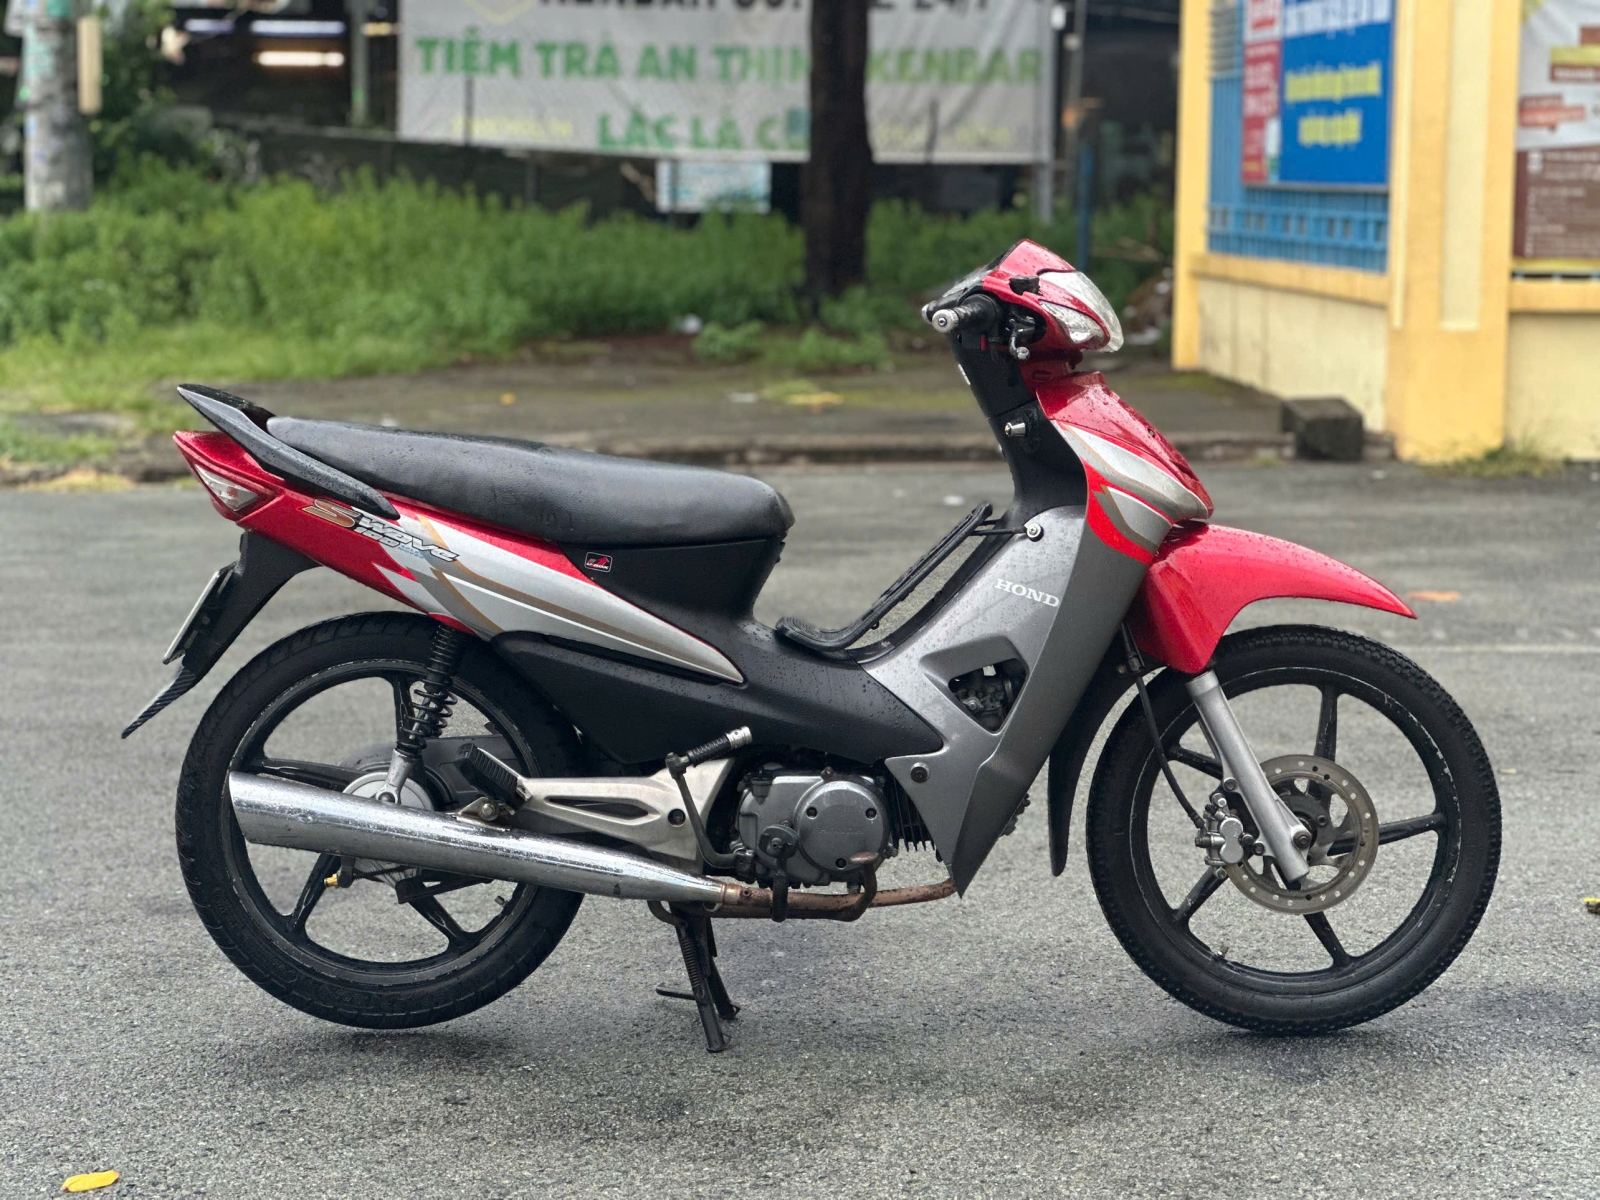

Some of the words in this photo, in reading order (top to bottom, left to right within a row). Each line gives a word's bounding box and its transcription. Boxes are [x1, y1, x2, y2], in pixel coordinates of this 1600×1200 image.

[637, 42, 698, 80] AN
[301, 498, 362, 528] S
[354, 526, 401, 548] 100
